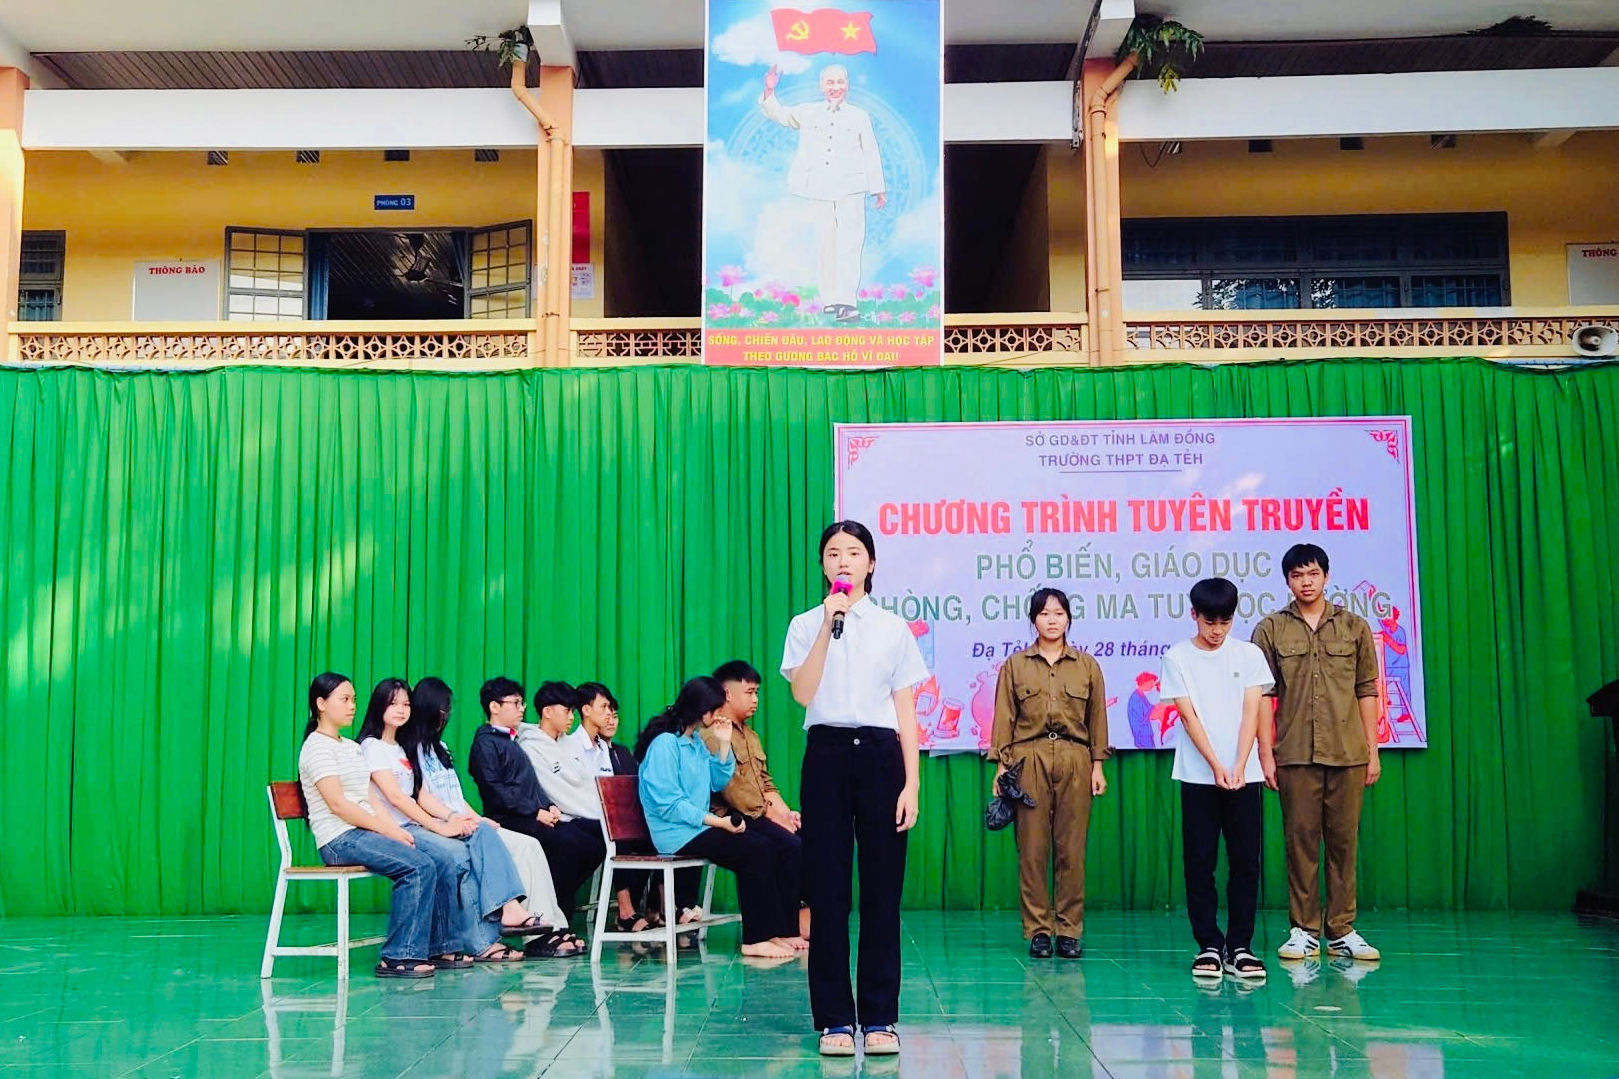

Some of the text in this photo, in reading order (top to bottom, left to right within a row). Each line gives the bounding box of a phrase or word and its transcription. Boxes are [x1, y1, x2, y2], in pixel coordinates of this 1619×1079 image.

[400, 197, 412, 206] 03
[1582, 247, 1617, 257] THÔNG
[149, 265, 182, 275] THÔNG
[811, 335, 832, 345] LAO
[869, 333, 884, 345] VÀ
[887, 335, 910, 347] HỌC
[743, 351, 772, 361] THEO
[1025, 431, 1045, 446] SỞ
[1050, 434, 1099, 446] GD&ĐT
[1103, 430, 1135, 445] TỈNH
[1141, 430, 1169, 444] LÂM
[1039, 452, 1101, 467] TRƯỜNG
[1106, 454, 1144, 465] THPT
[1149, 453, 1169, 467] ĐẠ
[879, 487, 1370, 536] CHƯƠNG TRÌNH TUYÊN TRUYỀN
[976, 539, 1272, 583] PHỔ BIẾN, GIÁO DỤC
[981, 583, 1085, 621] CHG
[1096, 594, 1139, 619] MA
[1148, 592, 1190, 619] TU
[1237, 592, 1276, 624] ỌC
[972, 642, 995, 660] Đạ
[1094, 642, 1114, 657] 28
